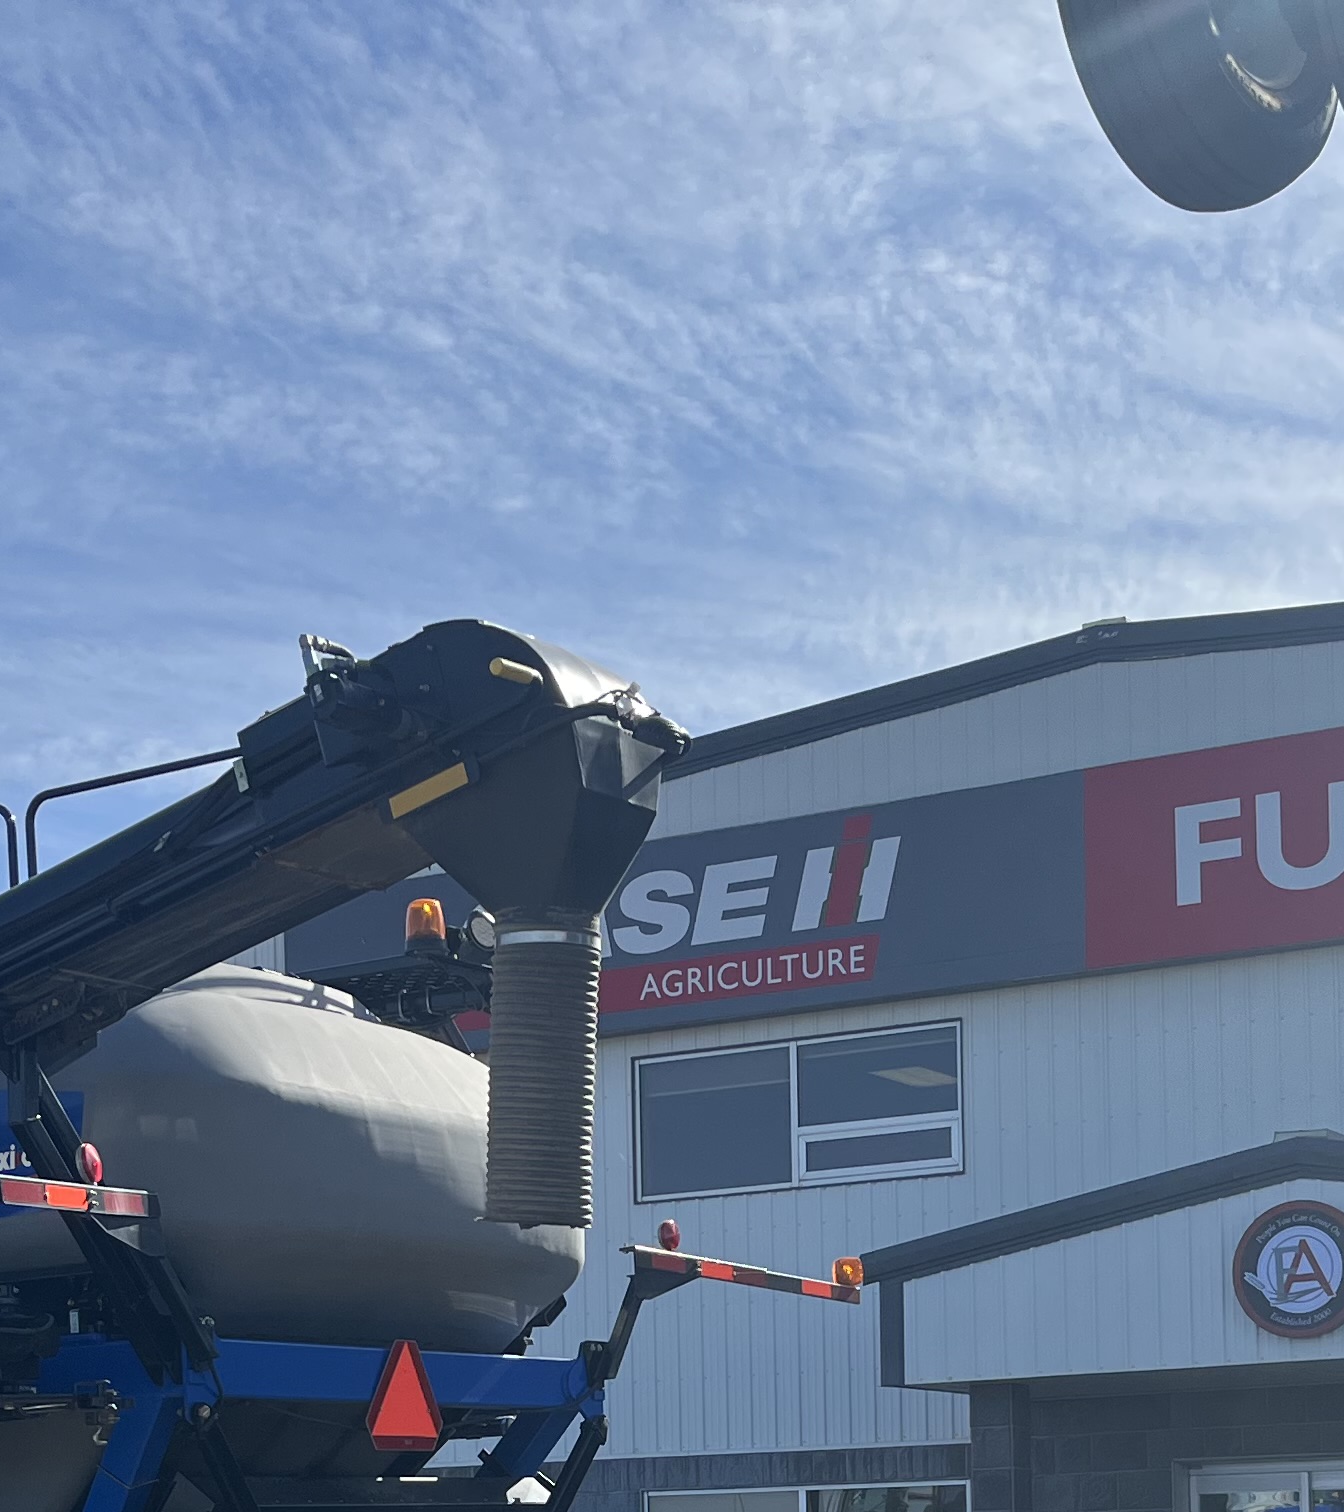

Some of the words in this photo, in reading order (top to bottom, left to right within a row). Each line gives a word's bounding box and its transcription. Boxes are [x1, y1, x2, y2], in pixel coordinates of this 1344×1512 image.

[601, 854, 778, 959] SE
[639, 945, 866, 1001] AGRICULTURE
[1276, 1216, 1291, 1227] You
[1291, 1213, 1309, 1222] Can
[1308, 1214, 1331, 1228] Count
[1270, 1311, 1312, 1326] Established
